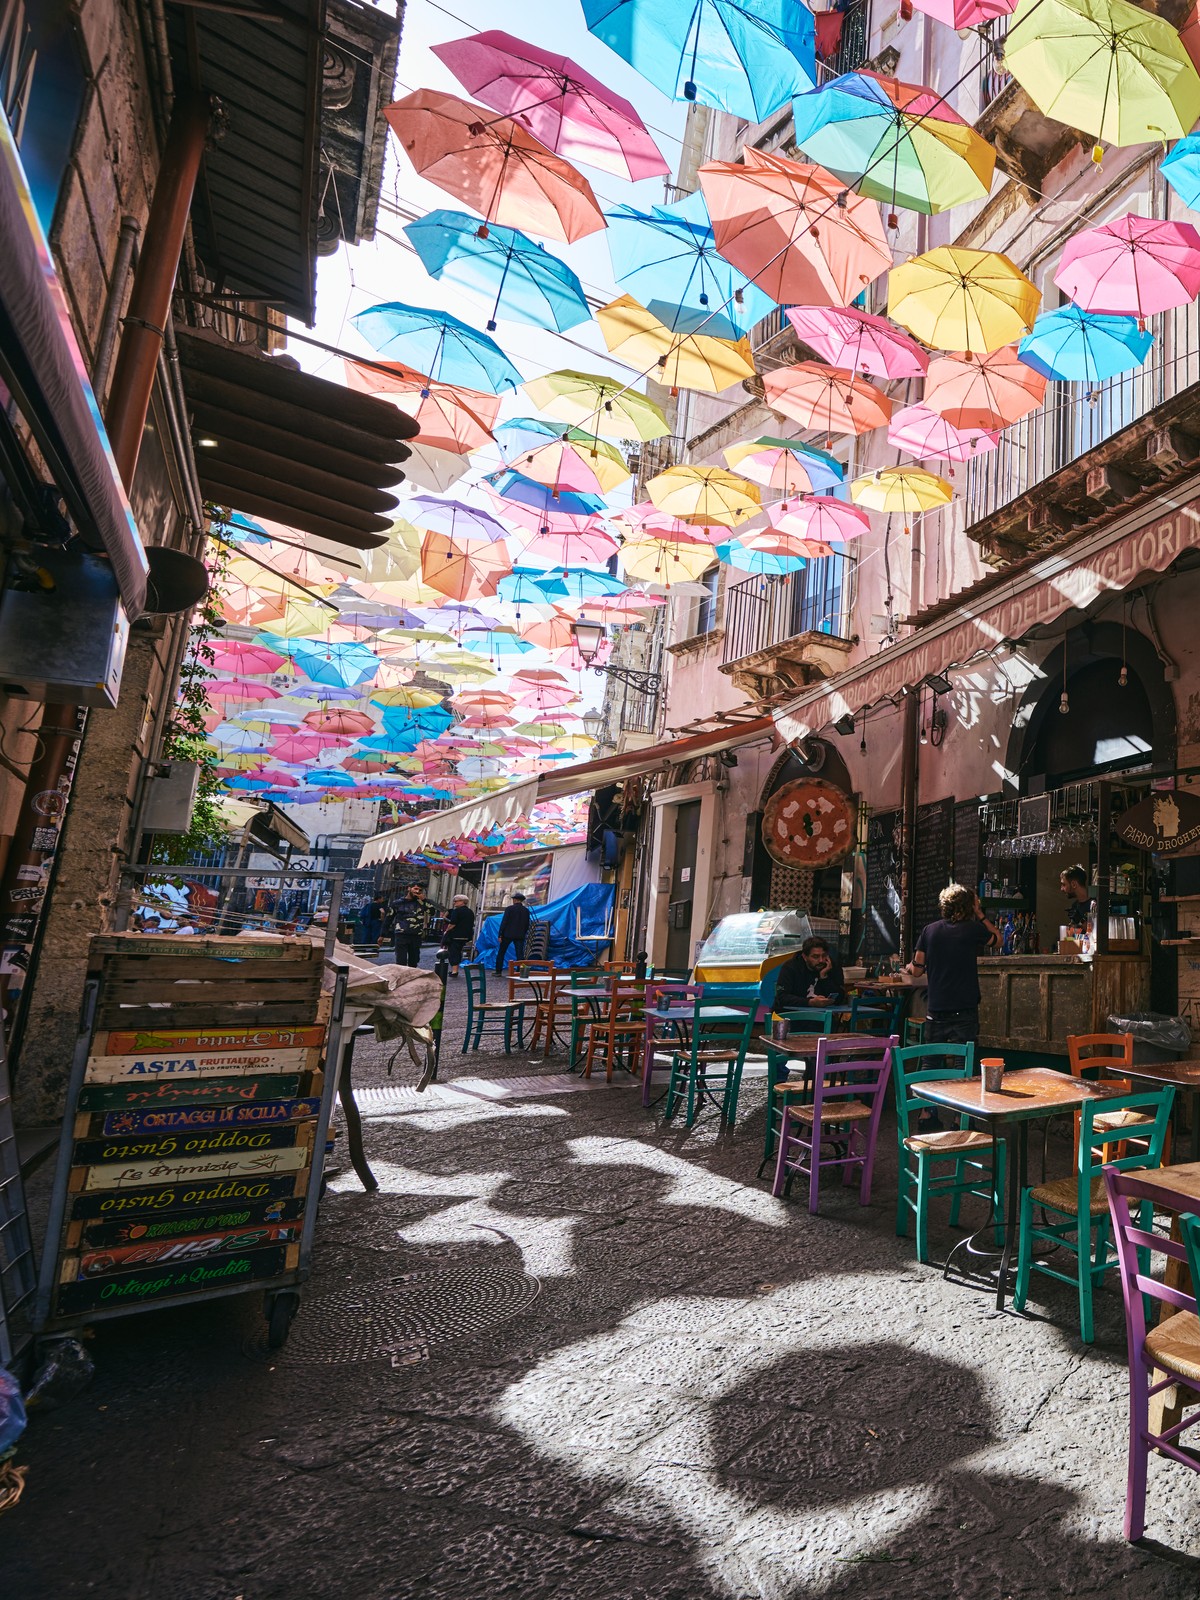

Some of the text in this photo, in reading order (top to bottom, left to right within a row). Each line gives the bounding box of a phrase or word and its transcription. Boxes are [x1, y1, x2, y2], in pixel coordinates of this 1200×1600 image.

[1123, 824, 1154, 848] PARDO
[196, 1031, 272, 1047] Frutta
[126, 1060, 198, 1075] ASTA
[126, 1083, 259, 1103] Primizie
[142, 1105, 288, 1128] ORTAGGI DI SICILIA
[102, 1131, 271, 1159] Doppio Gusto
[114, 1160, 240, 1181] Le Primizie
[100, 1181, 270, 1211] Doppio Gusto
[100, 1259, 253, 1300] Ortaggi di Qualità
